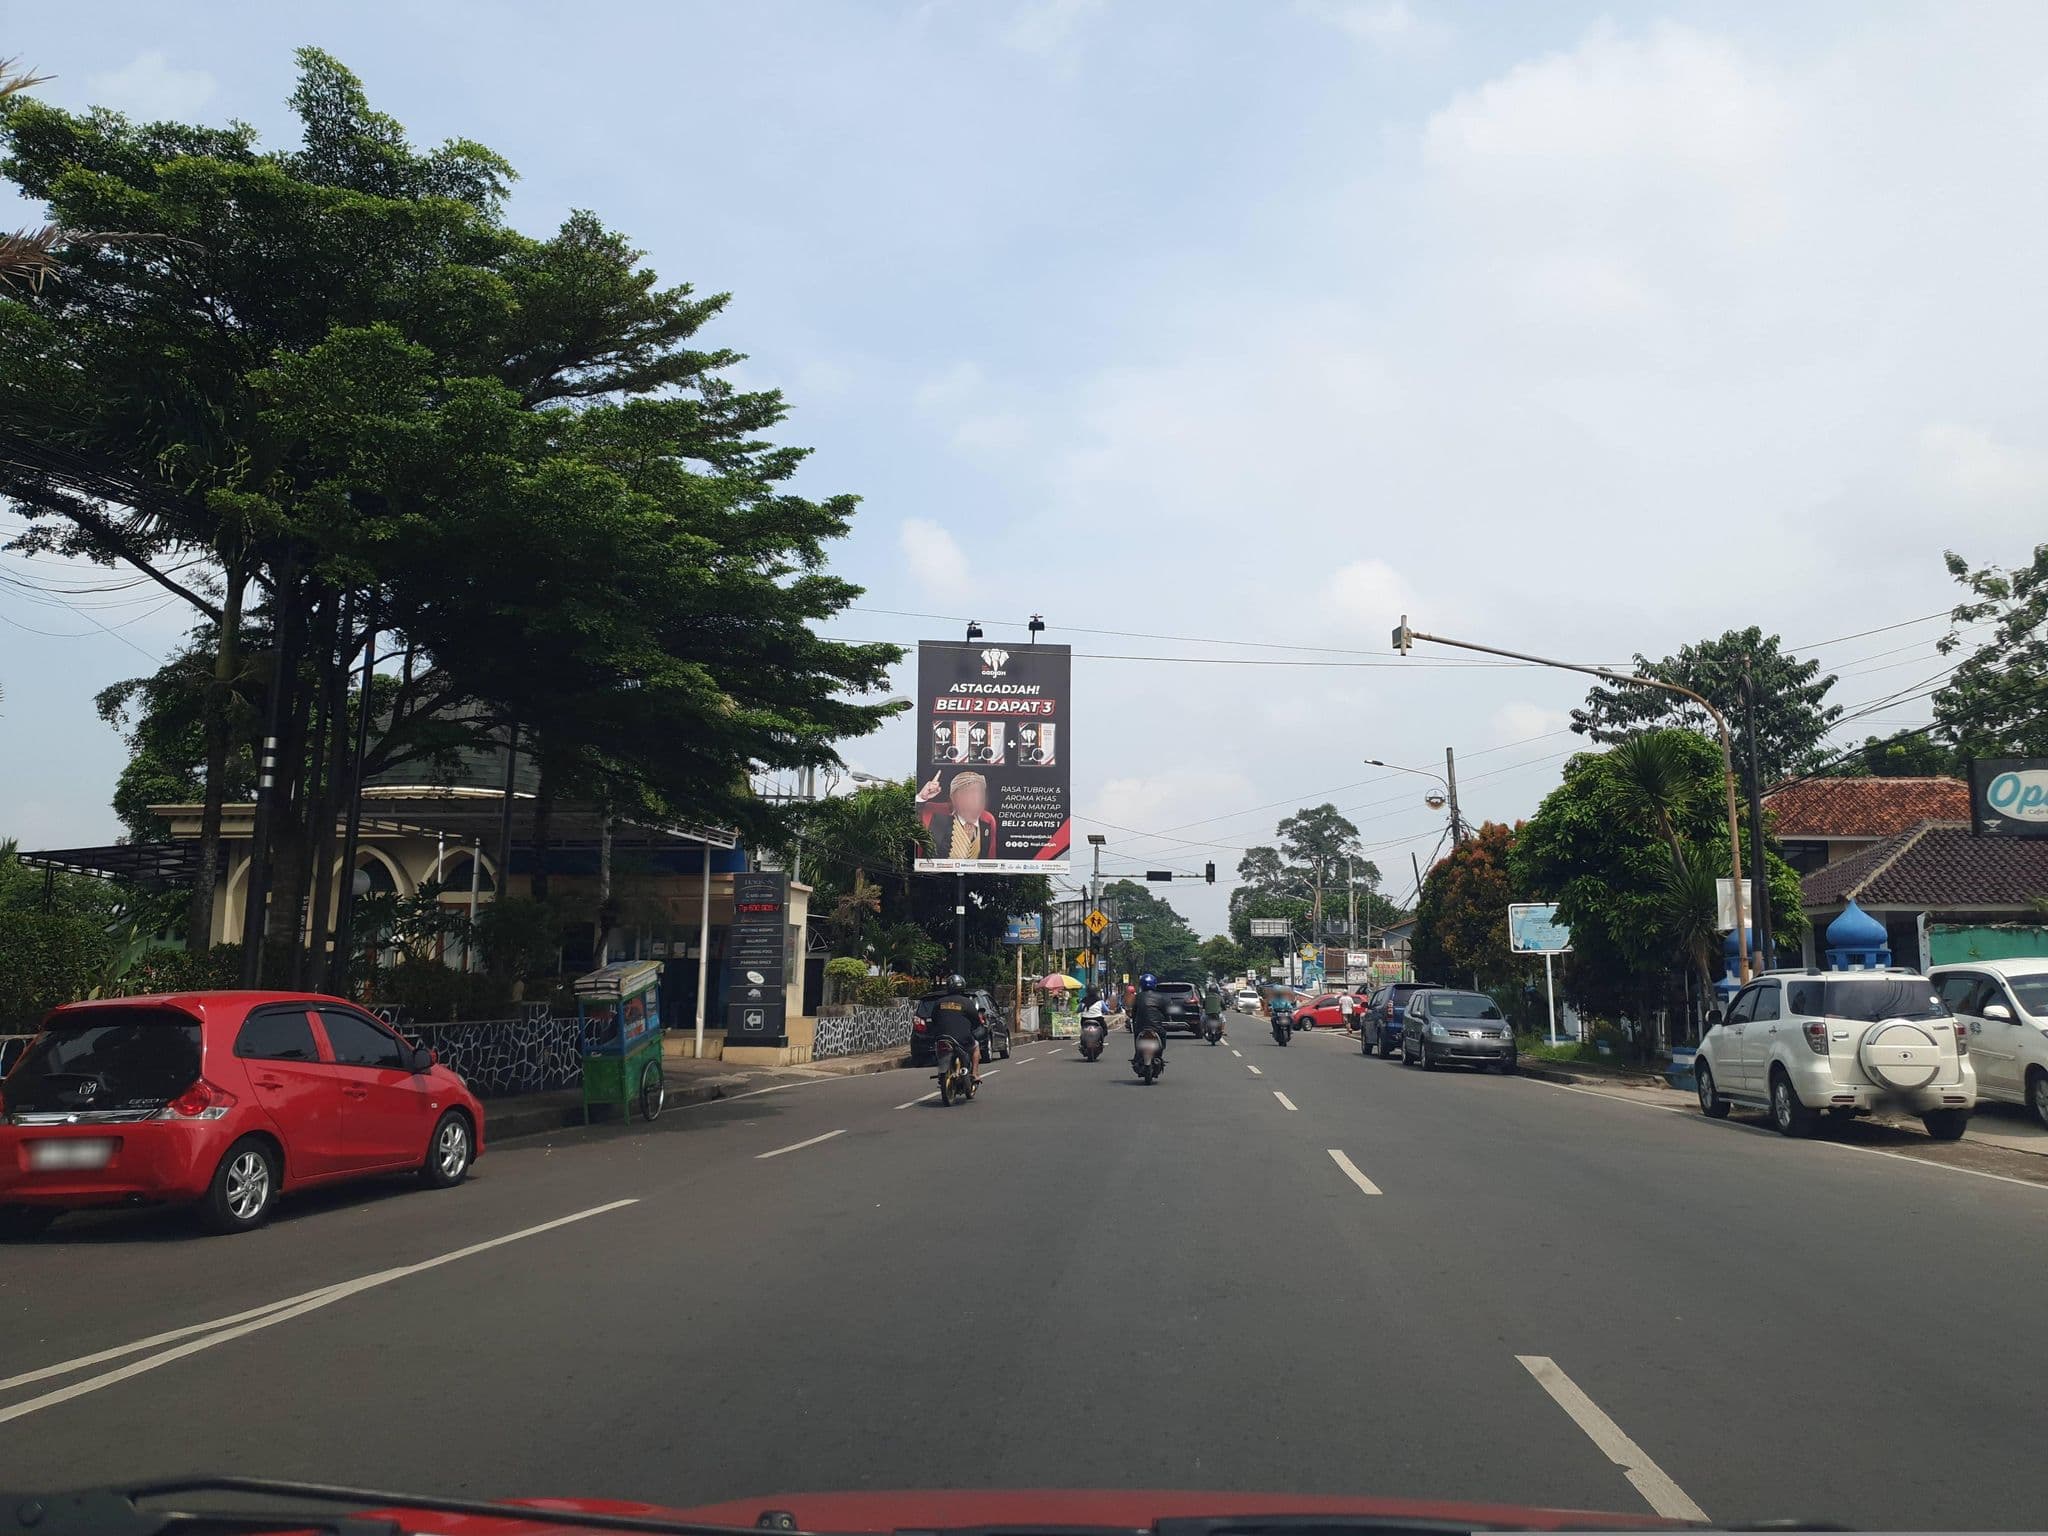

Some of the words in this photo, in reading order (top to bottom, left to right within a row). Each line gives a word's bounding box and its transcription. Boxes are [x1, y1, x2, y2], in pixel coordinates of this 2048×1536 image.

[949, 683, 1041, 695] ASTAGADJAH!
[936, 699, 971, 711] BELI
[973, 700, 983, 712] 2
[987, 701, 1040, 713] DAPAT
[1041, 701, 1053, 714] 3
